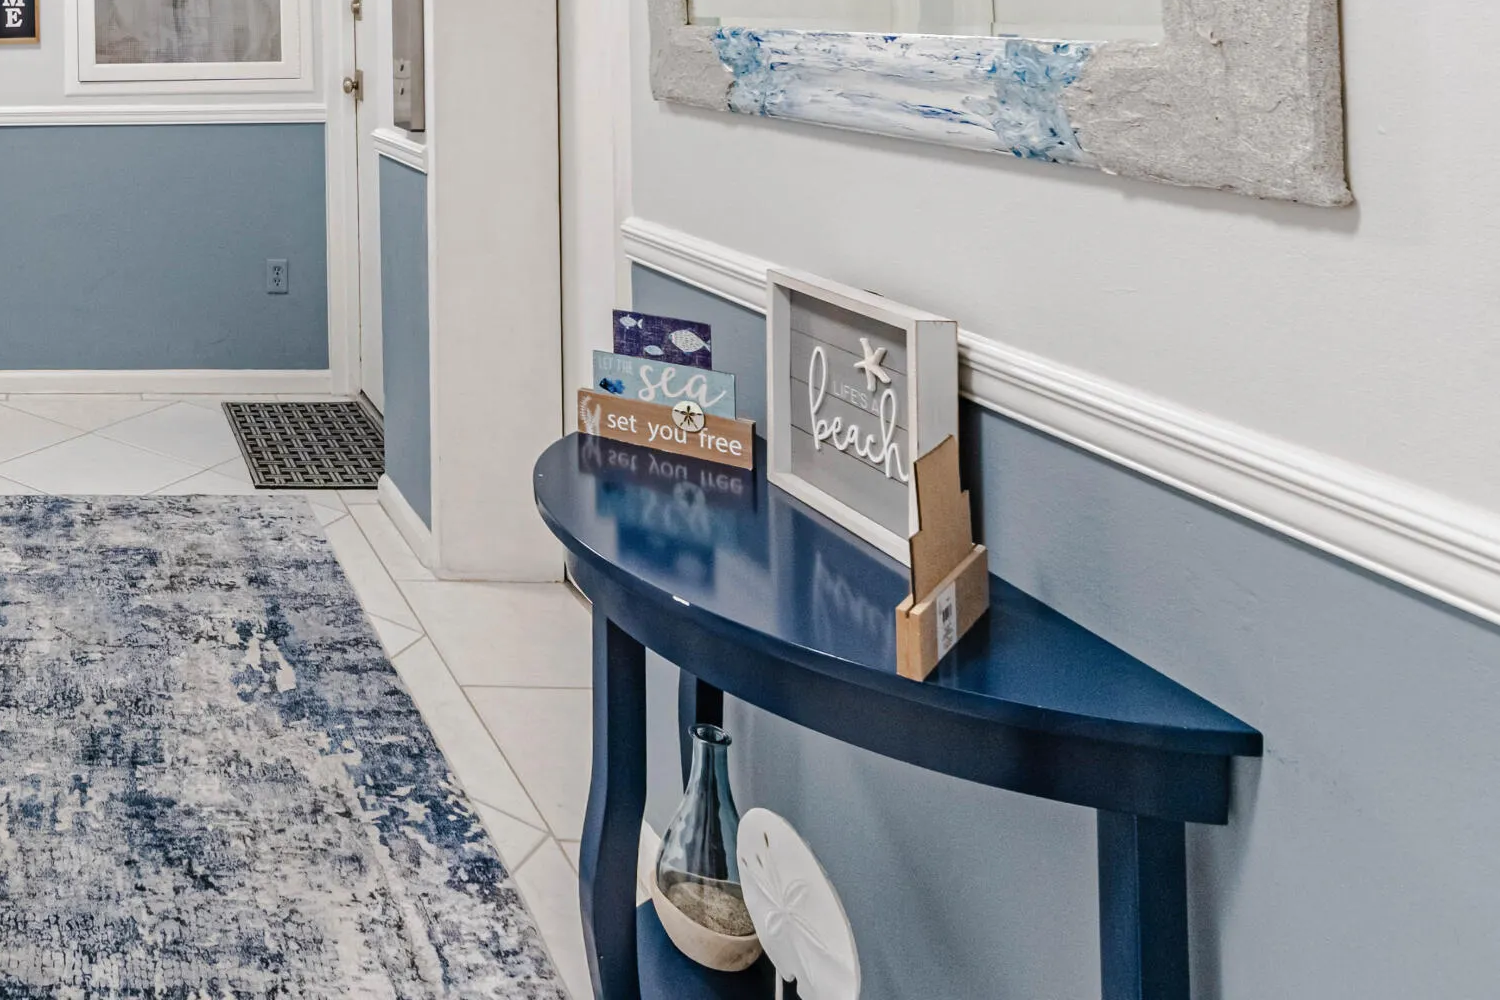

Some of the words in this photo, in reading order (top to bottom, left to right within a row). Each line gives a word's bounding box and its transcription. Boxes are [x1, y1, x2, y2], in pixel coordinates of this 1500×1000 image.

[638, 364, 727, 408] sea
[607, 413, 637, 433] set
[648, 420, 687, 444] you
[698, 427, 743, 456] free
[809, 346, 910, 482] beach
